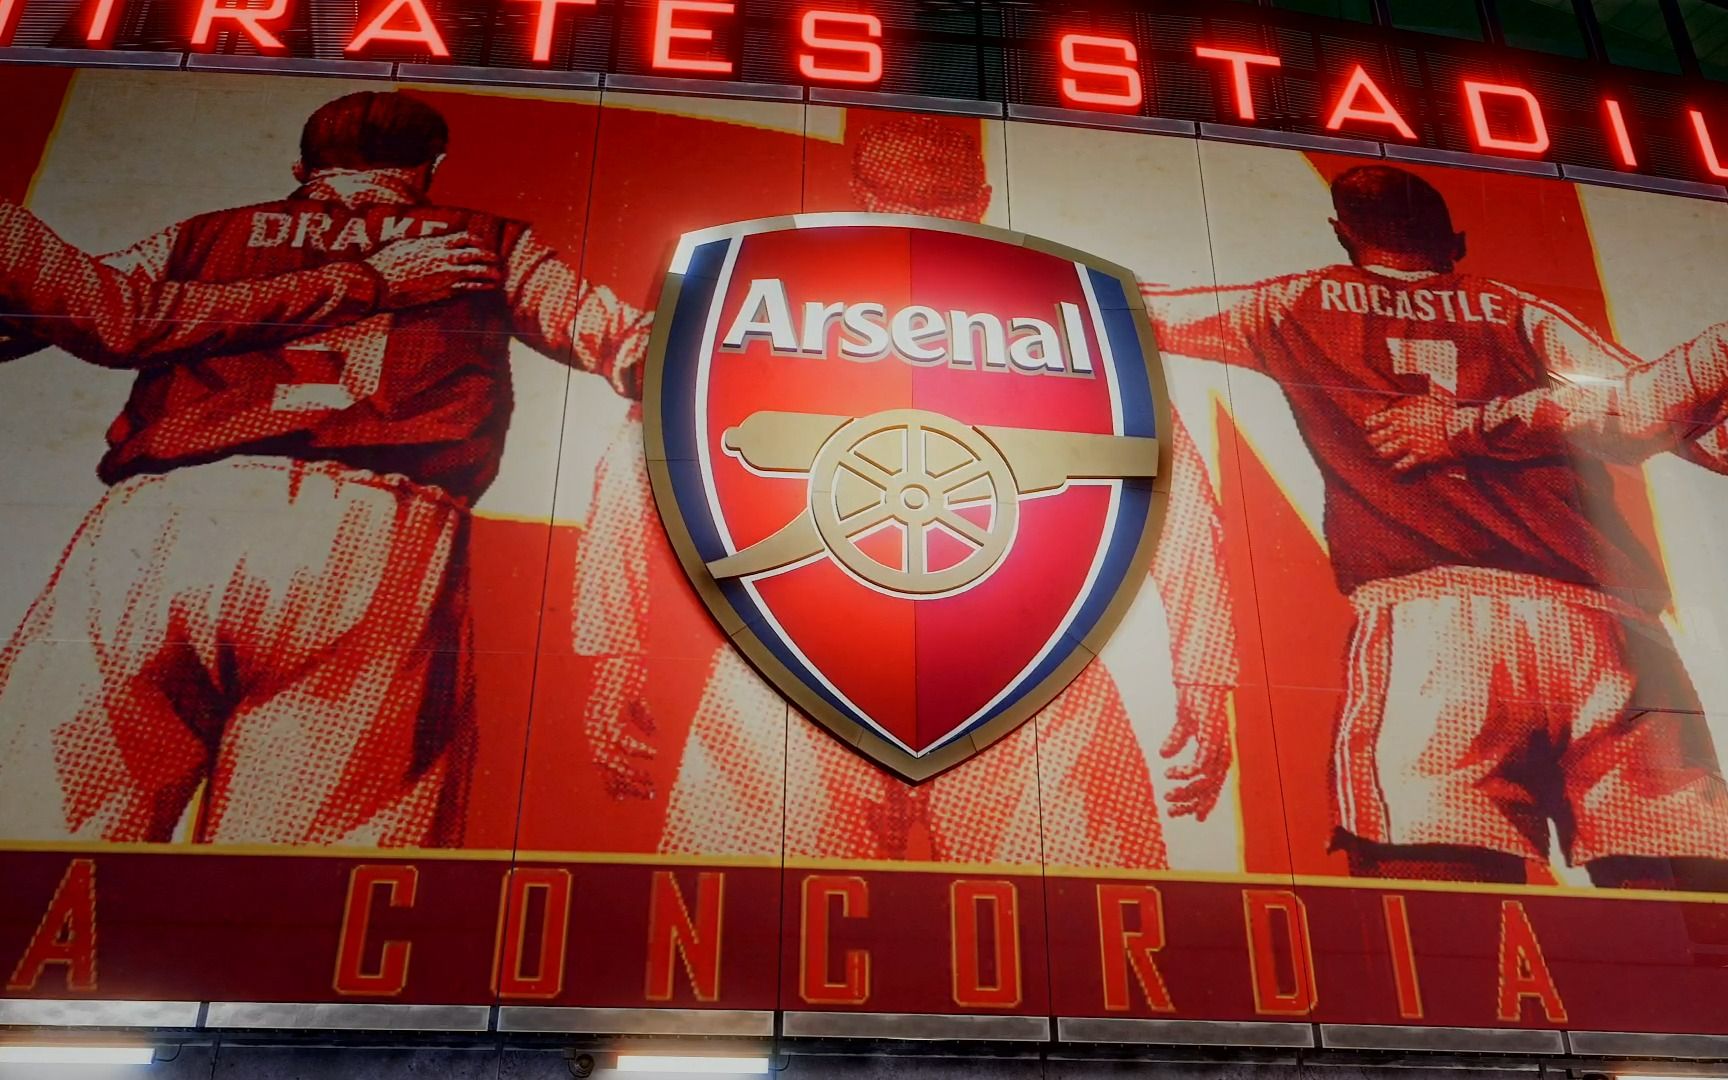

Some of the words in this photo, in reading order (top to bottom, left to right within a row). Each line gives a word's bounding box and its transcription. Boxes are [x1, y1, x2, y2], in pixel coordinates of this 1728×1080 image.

[0, 0, 884, 83] IRATES
[718, 278, 1096, 379] Arsenal
[1319, 279, 1508, 325] ROCASTLE
[332, 864, 1568, 1022] CONCORDIA
